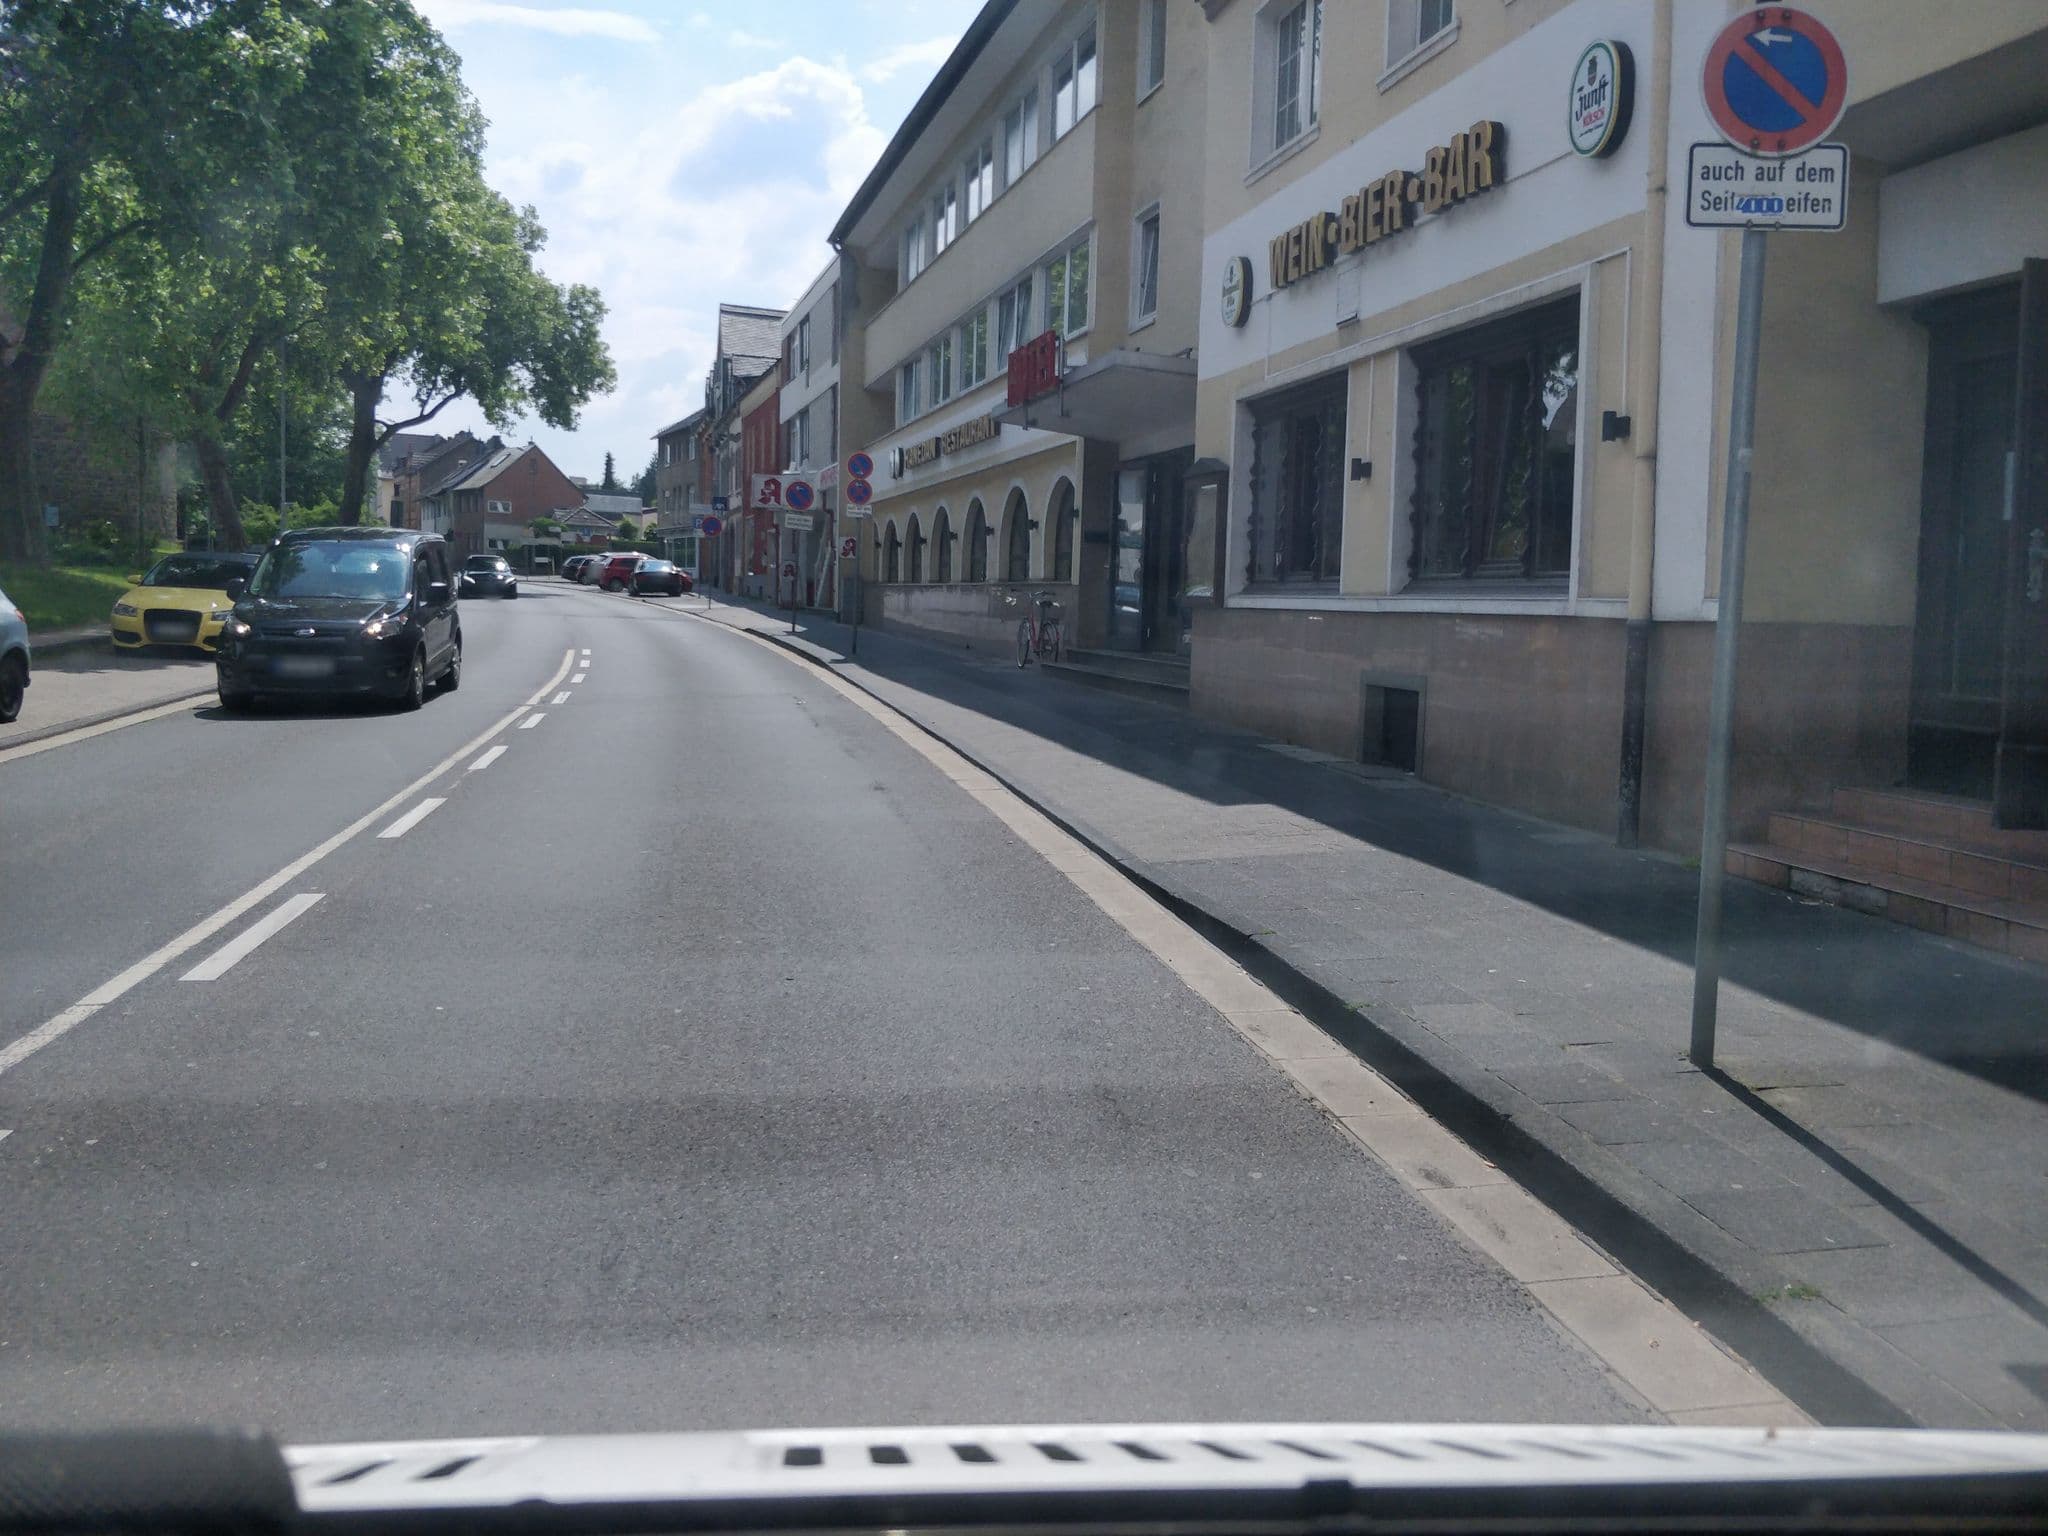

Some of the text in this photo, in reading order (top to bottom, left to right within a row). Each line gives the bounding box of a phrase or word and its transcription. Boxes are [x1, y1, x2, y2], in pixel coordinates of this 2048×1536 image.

[1269, 120, 1500, 290] WEIN BIER BAR
[1700, 159, 1835, 183] auch auf dem
